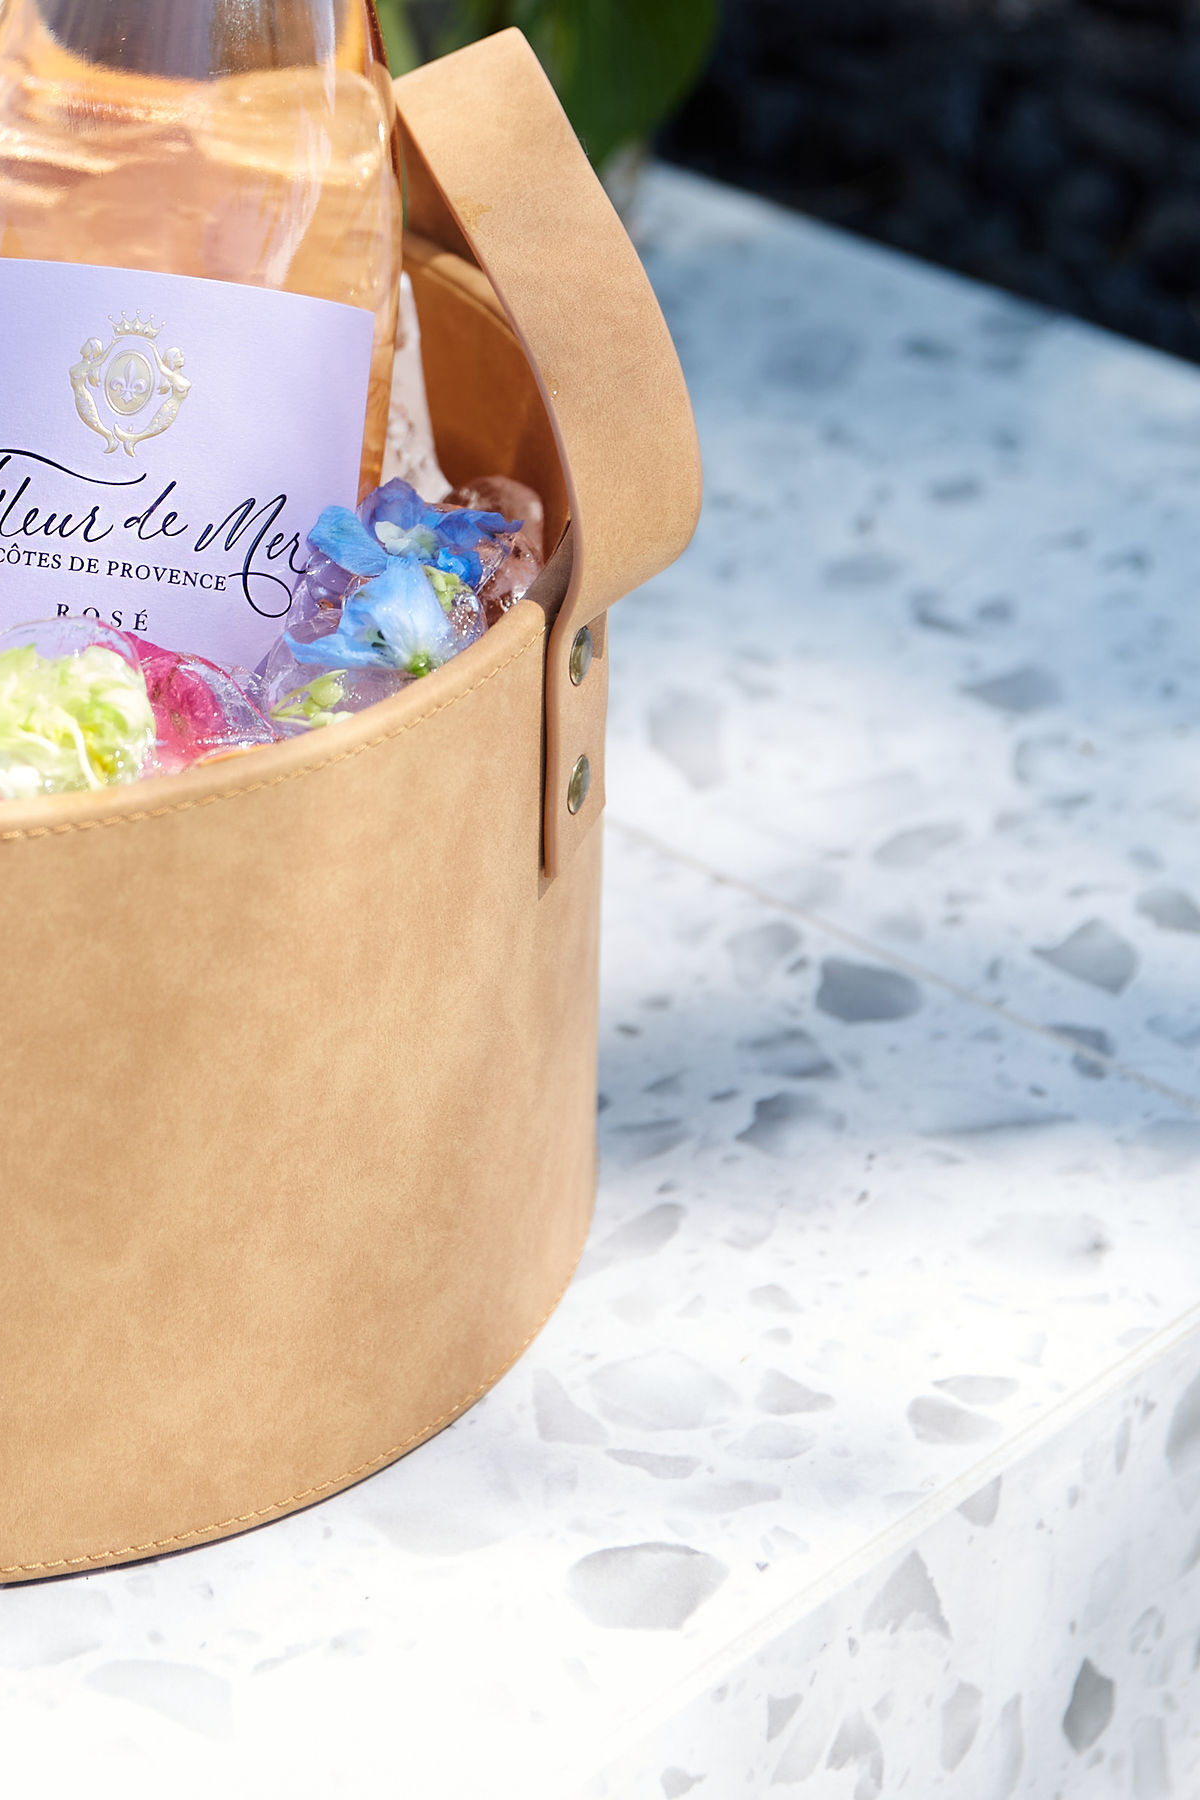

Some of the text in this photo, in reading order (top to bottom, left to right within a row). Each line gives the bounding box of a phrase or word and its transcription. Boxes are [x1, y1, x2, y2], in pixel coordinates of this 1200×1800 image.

[68, 555, 100, 575] DE
[106, 560, 227, 592] PROVENCE
[123, 480, 189, 540] de
[193, 493, 307, 618] Mer
